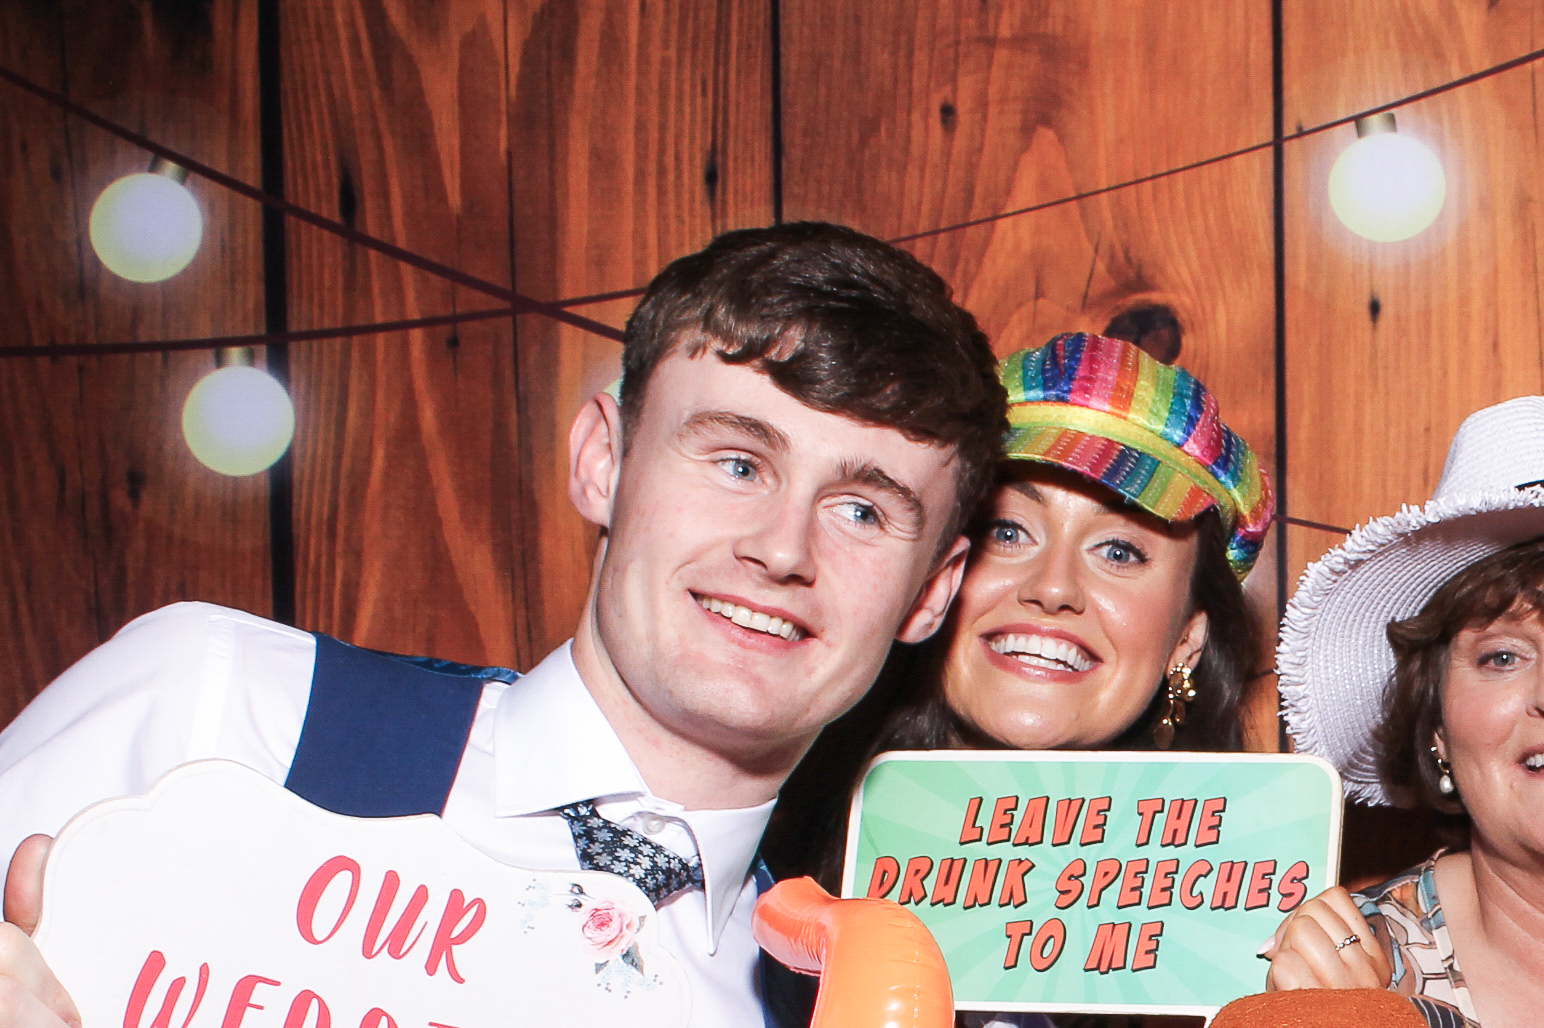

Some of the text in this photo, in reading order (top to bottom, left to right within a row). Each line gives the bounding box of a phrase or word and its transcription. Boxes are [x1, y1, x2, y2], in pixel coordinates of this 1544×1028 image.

[959, 795, 1227, 849] LEAVE THE
[868, 856, 1310, 912] DRUNK SPEECHES
[296, 854, 487, 985] OUR
[1003, 918, 1165, 975] TO ME
